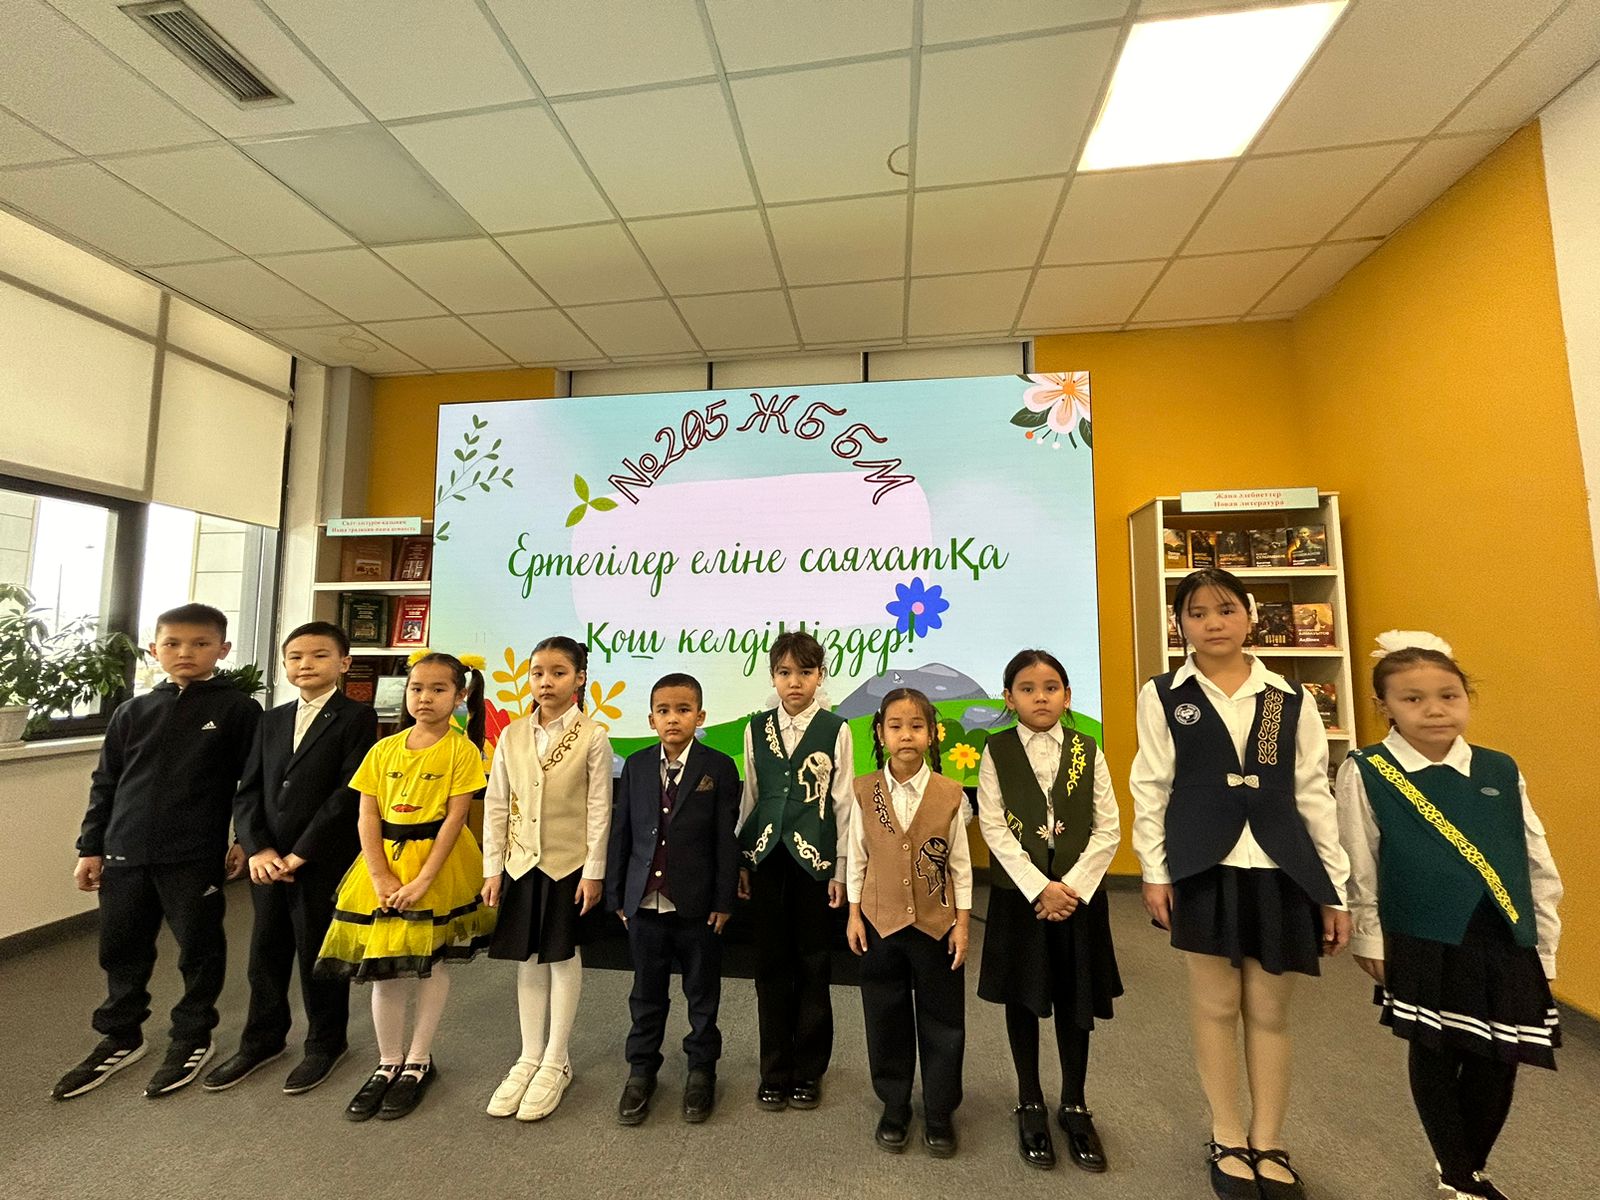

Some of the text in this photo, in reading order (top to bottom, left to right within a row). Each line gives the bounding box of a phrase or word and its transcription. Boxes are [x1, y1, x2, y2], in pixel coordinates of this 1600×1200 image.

[608, 399, 729, 505] №205
[508, 531, 680, 599] Ертегілер
[691, 541, 787, 575] еліне
[586, 609, 916, 678] Қош келдііздер!
